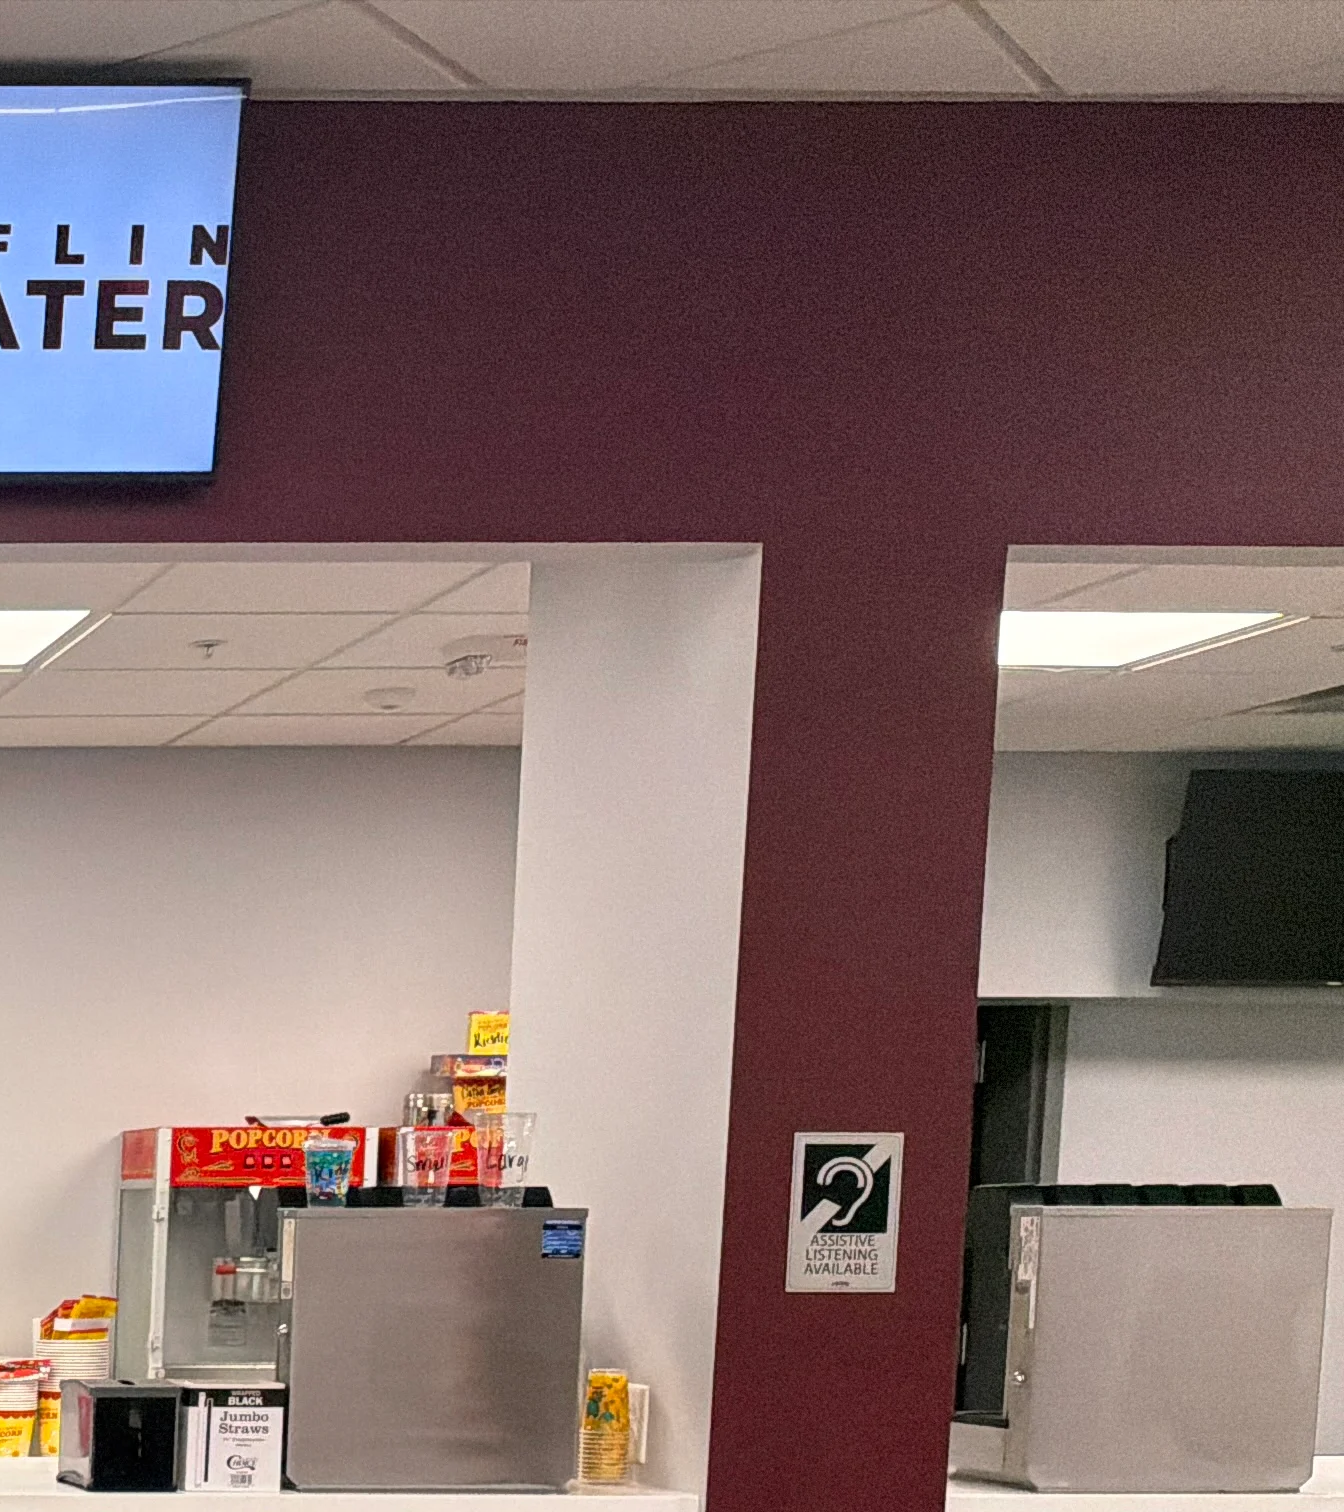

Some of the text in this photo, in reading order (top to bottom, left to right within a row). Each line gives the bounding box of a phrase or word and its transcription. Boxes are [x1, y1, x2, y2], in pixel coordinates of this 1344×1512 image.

[810, 1235, 875, 1247] ASSISTIVE
[805, 1249, 878, 1261] LISTENING
[804, 1262, 878, 1275] AVAILABLE
[227, 1396, 263, 1406] BLACK
[220, 1411, 269, 1422] Jumbo
[218, 1423, 269, 1434] Straws
